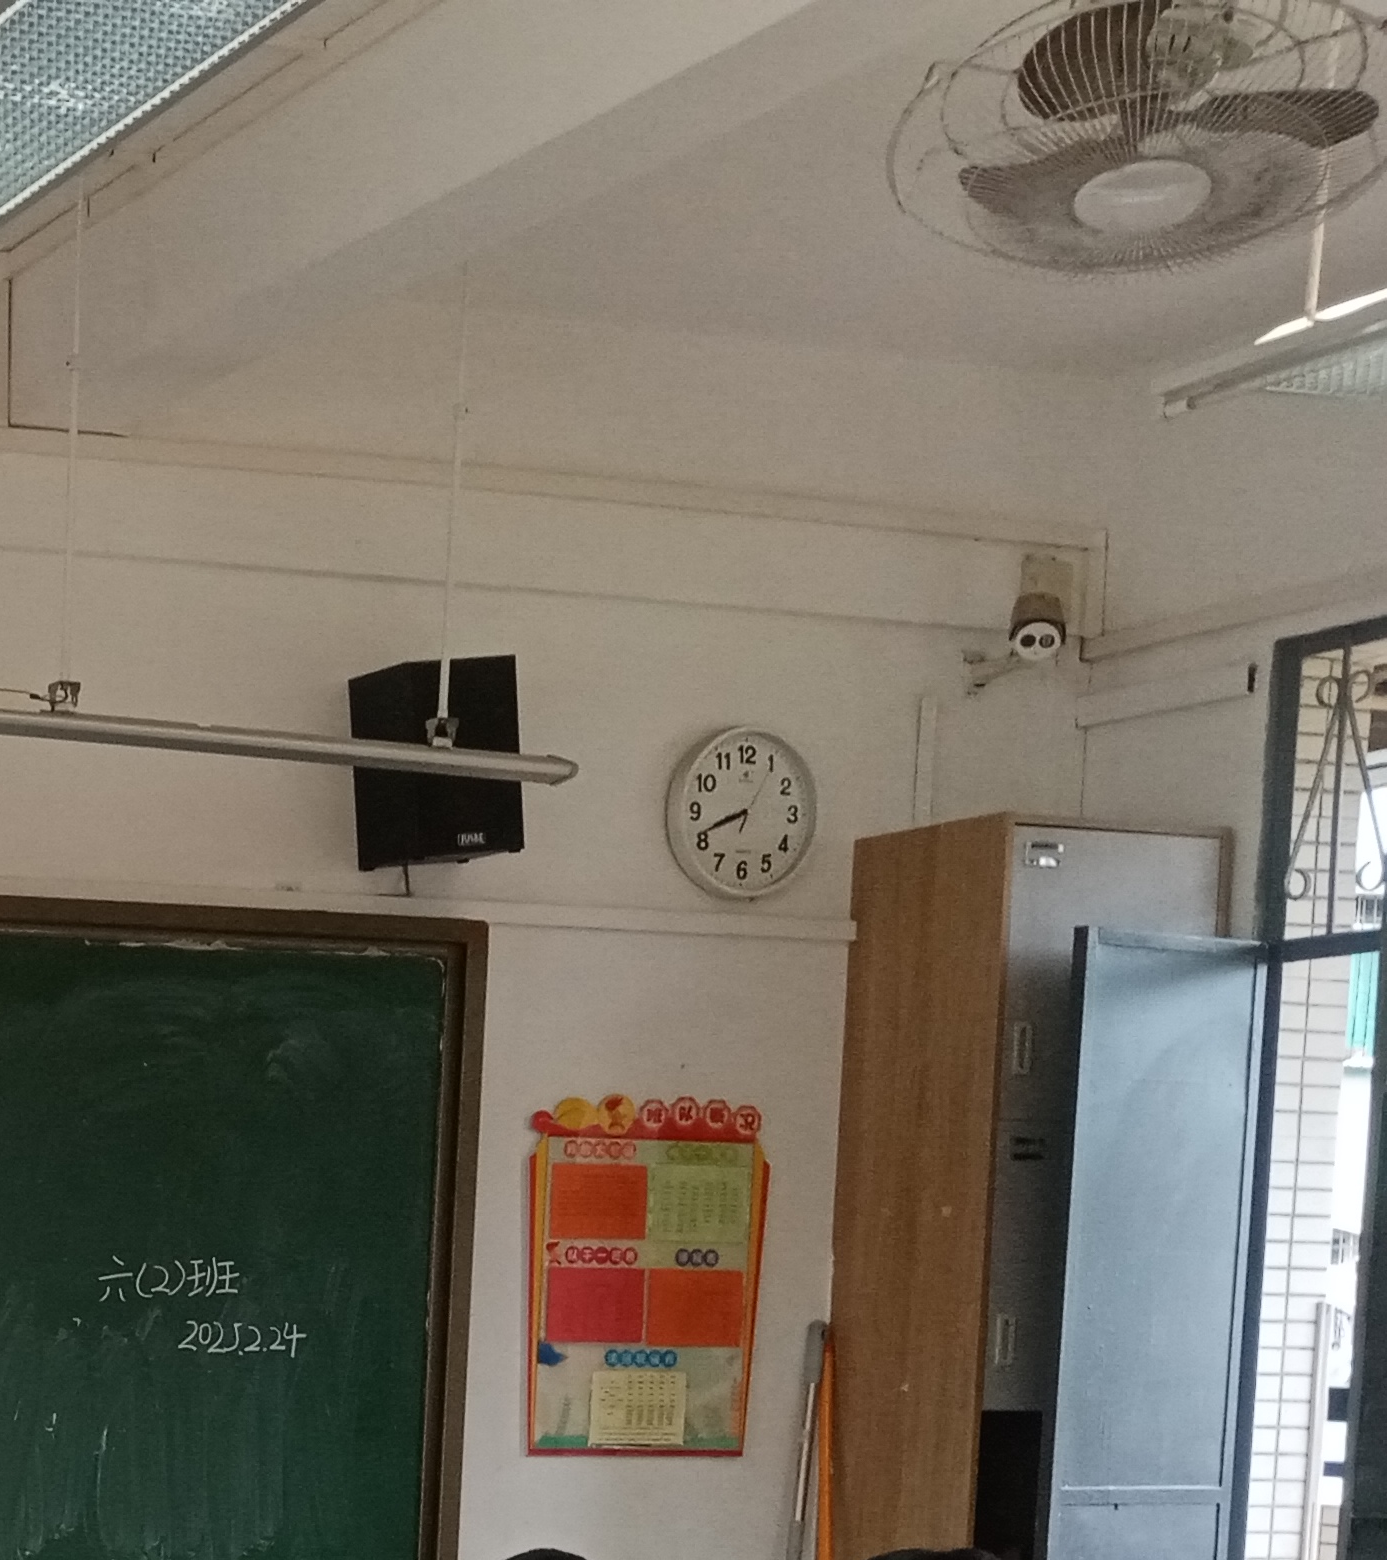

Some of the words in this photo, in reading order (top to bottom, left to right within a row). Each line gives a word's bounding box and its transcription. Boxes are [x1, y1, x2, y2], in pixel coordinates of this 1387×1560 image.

[716, 752, 731, 770] 11
[738, 745, 756, 764] 12
[768, 754, 774, 772] 1
[696, 773, 717, 793] 10
[780, 777, 792, 796] 2
[689, 801, 701, 821] 9
[786, 805, 798, 824] 3
[696, 832, 709, 851] 8
[778, 834, 789, 853] 4
[713, 852, 725, 872] 7
[736, 860, 747, 880] 6
[760, 853, 771, 873] 5
[97, 1255, 240, 1302] 六(2)班
[178, 1320, 307, 1358] 2025.2.24
